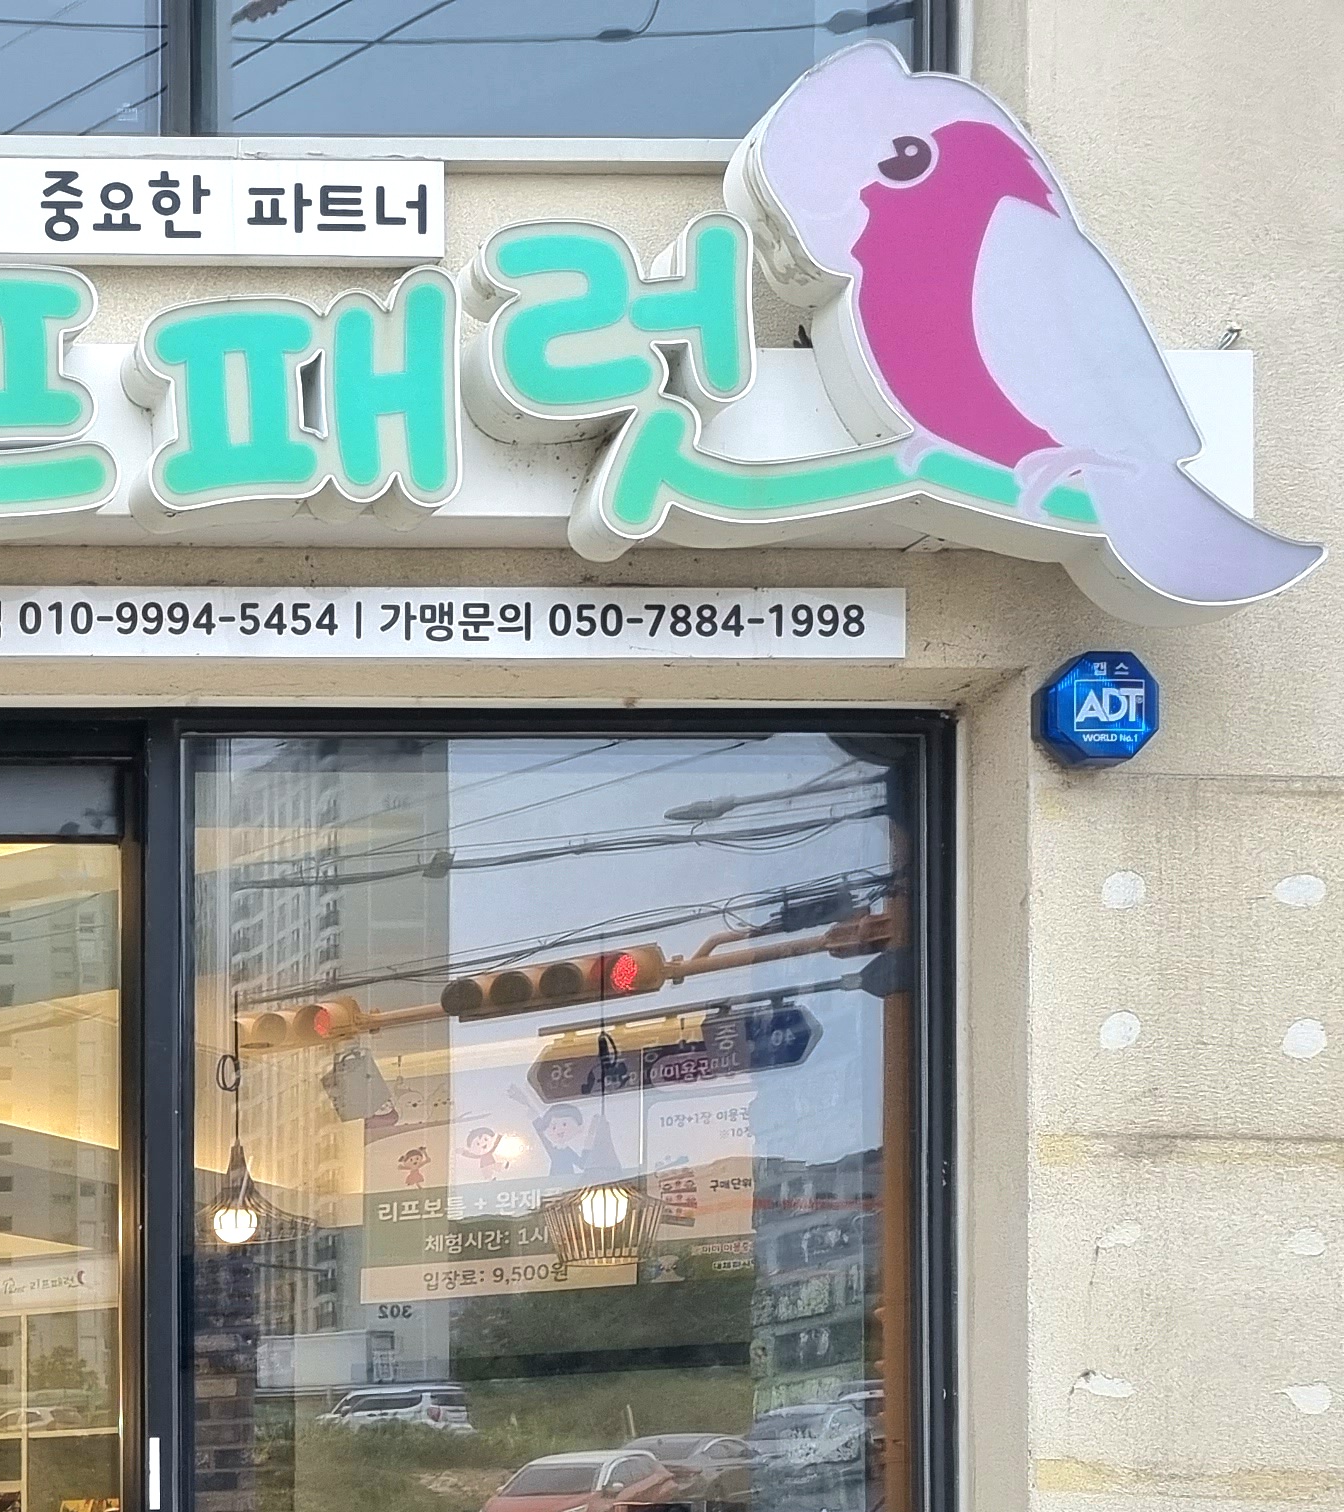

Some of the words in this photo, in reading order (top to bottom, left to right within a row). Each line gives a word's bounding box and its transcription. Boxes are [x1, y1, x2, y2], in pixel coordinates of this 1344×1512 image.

[39, 168, 210, 242] 중요한
[247, 180, 429, 238] 파트너
[18, 600, 339, 637] 010-9994-5454
[379, 600, 535, 642] 가맹문의
[547, 601, 867, 638] 050-7884-1998
[1075, 687, 1144, 722] ADT
[1082, 733, 1118, 742] WORLD
[377, 1196, 466, 1222] 리프보틀
[424, 1232, 510, 1255] 체험시간:
[423, 1269, 485, 1291] 입장료:
[492, 1263, 570, 1285] 9,500원
